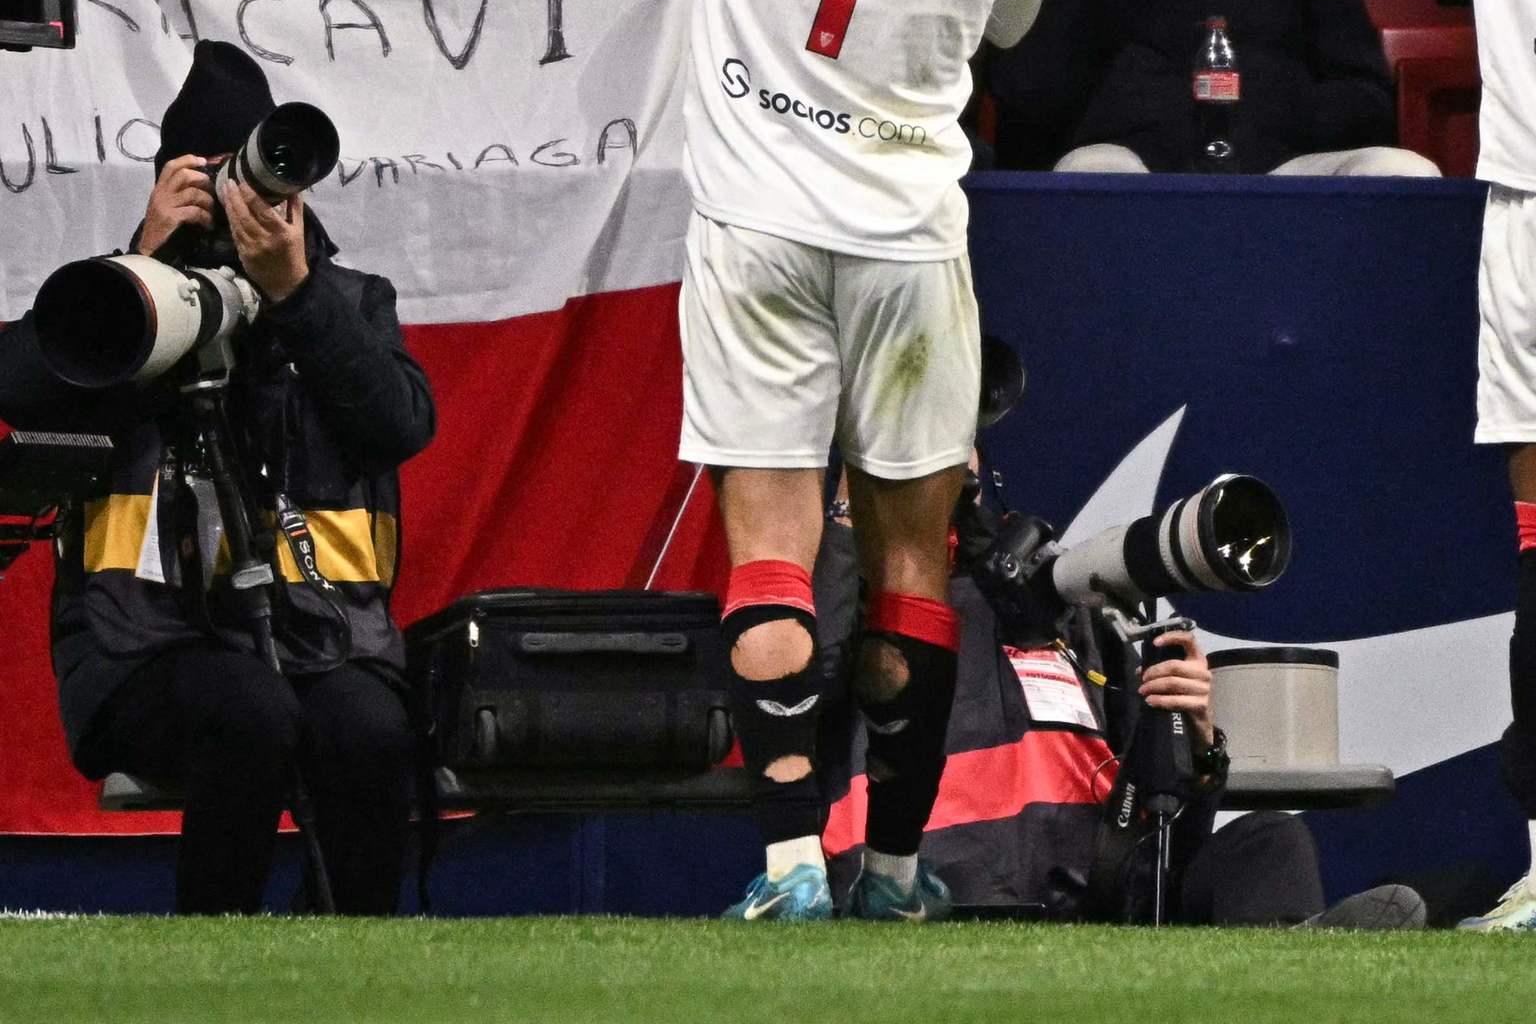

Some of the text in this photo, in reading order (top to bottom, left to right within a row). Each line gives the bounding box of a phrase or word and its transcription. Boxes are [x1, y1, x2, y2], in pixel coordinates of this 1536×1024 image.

[336, 118, 638, 188] VARIAGA
[299, 540, 336, 591] SONY
[1117, 782, 1137, 828] Canon
